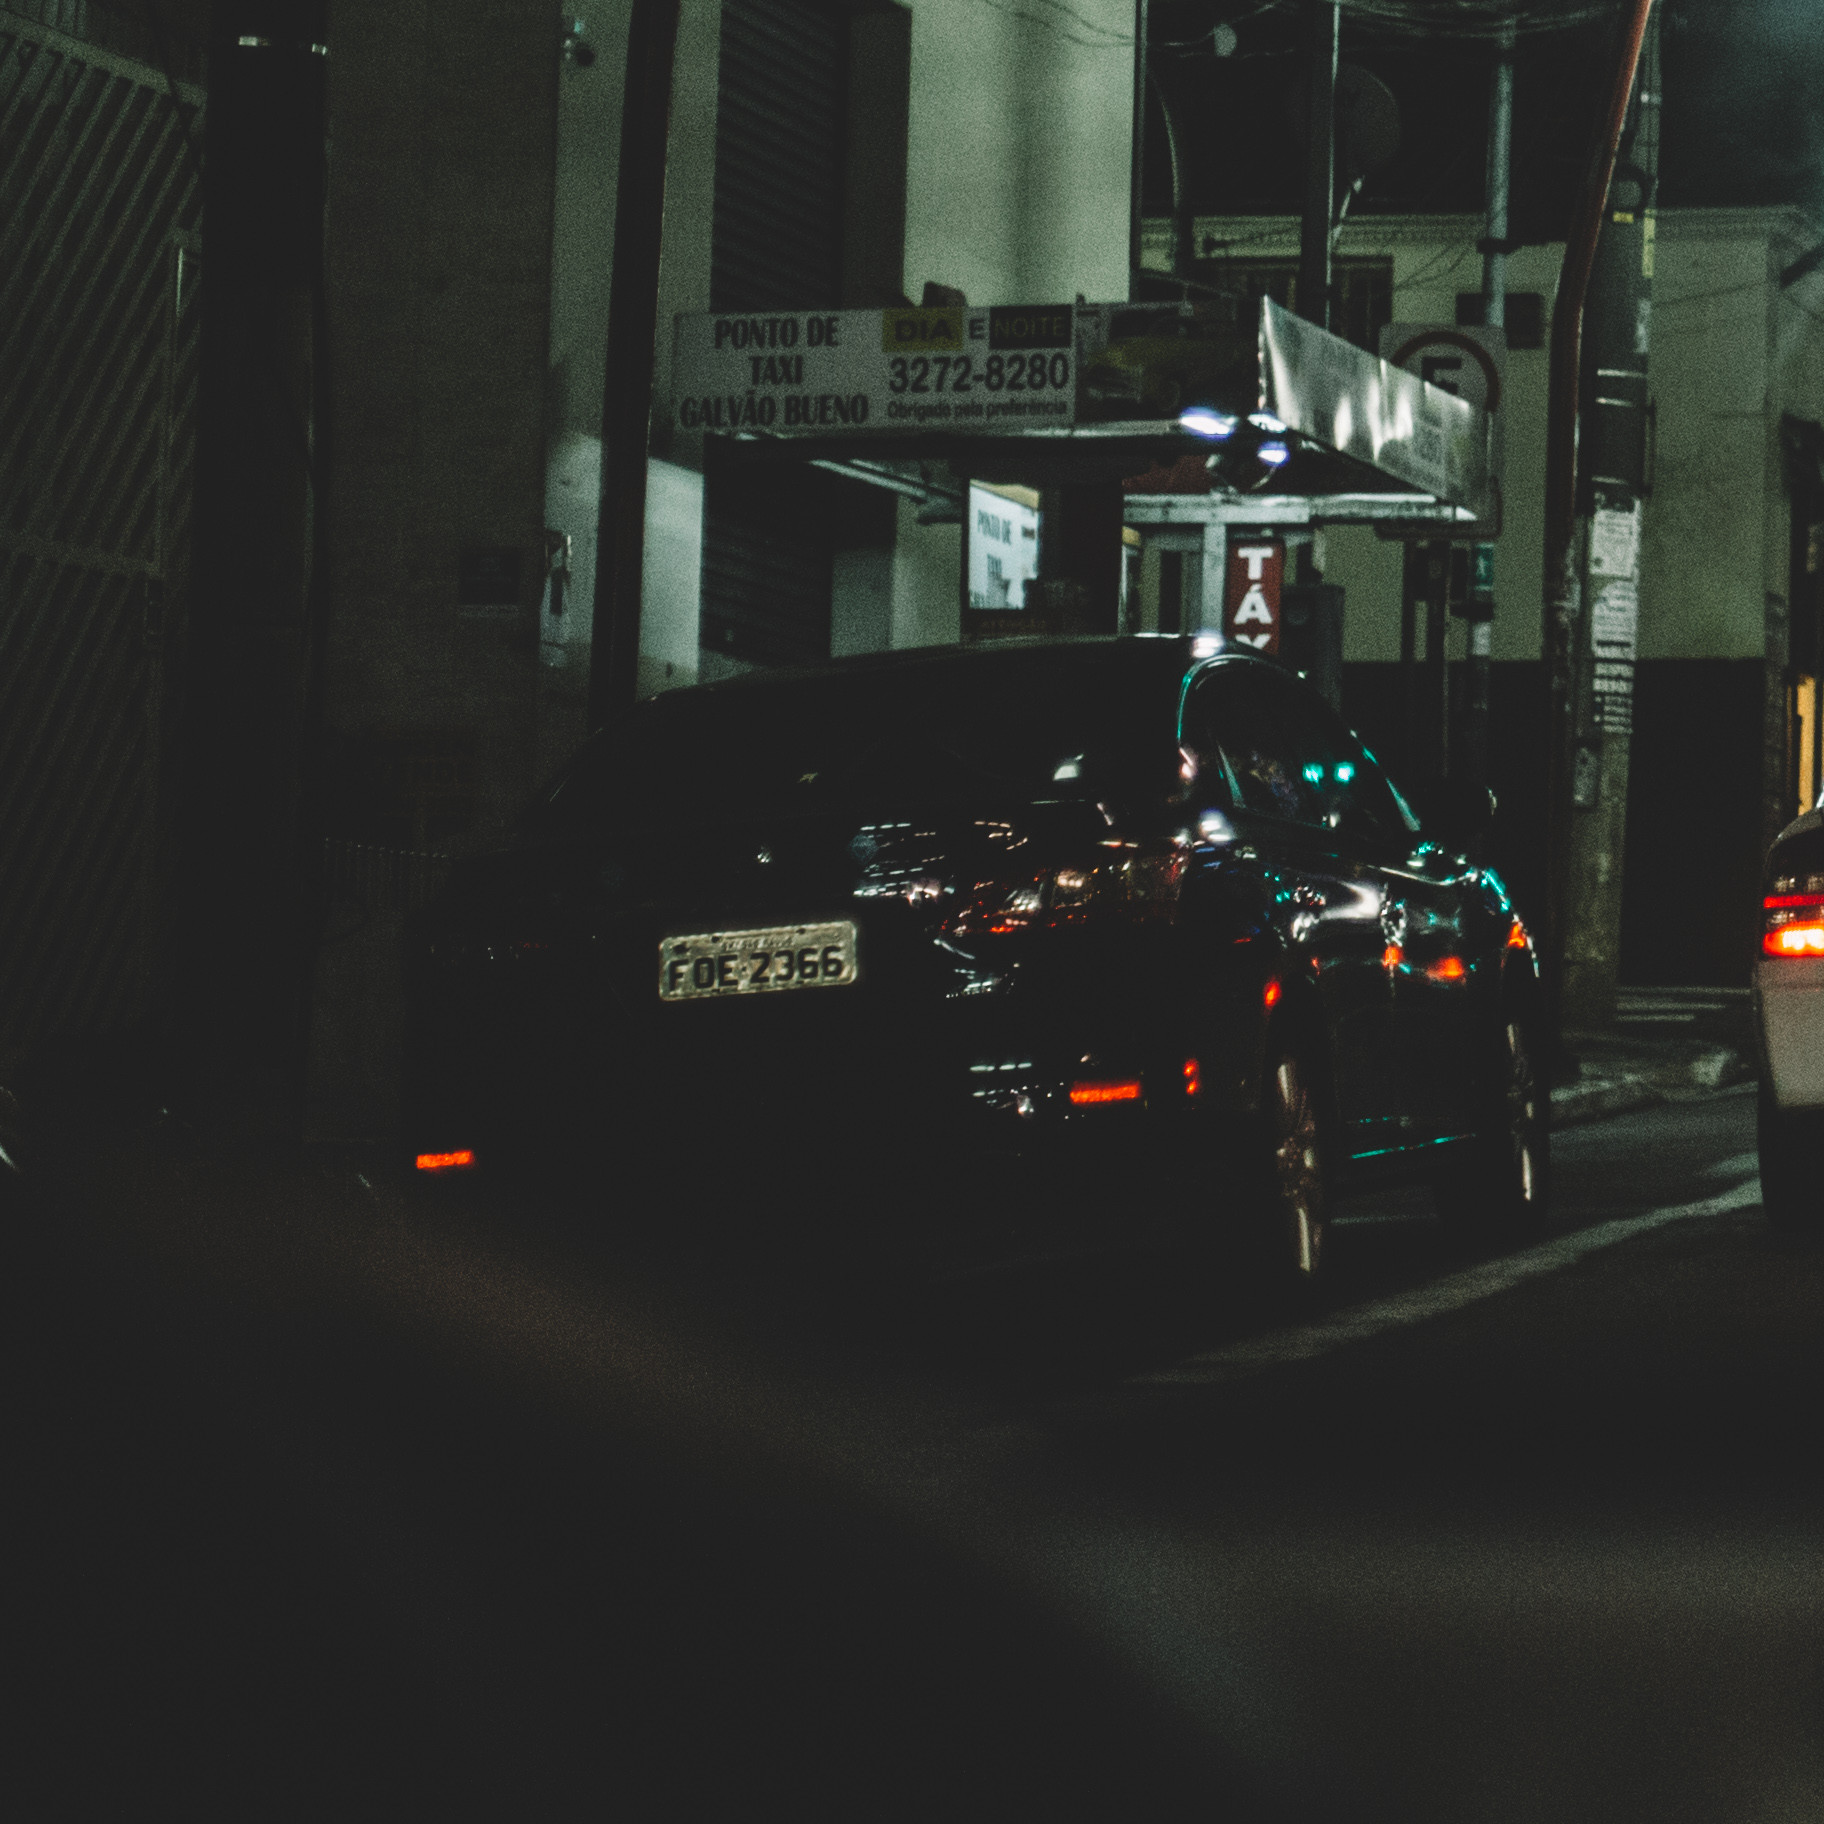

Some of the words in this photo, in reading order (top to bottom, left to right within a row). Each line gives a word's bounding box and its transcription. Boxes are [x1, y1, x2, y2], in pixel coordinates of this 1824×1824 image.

[714, 317, 800, 350] PONTO
[806, 315, 840, 347] DE
[895, 318, 953, 341] DIA
[968, 317, 985, 340] E
[994, 315, 1067, 338] NOITE
[749, 355, 804, 386] TAXI
[889, 352, 1069, 394] 3272-8280
[679, 389, 777, 427] GALVÃO
[785, 393, 869, 425] BUENO
